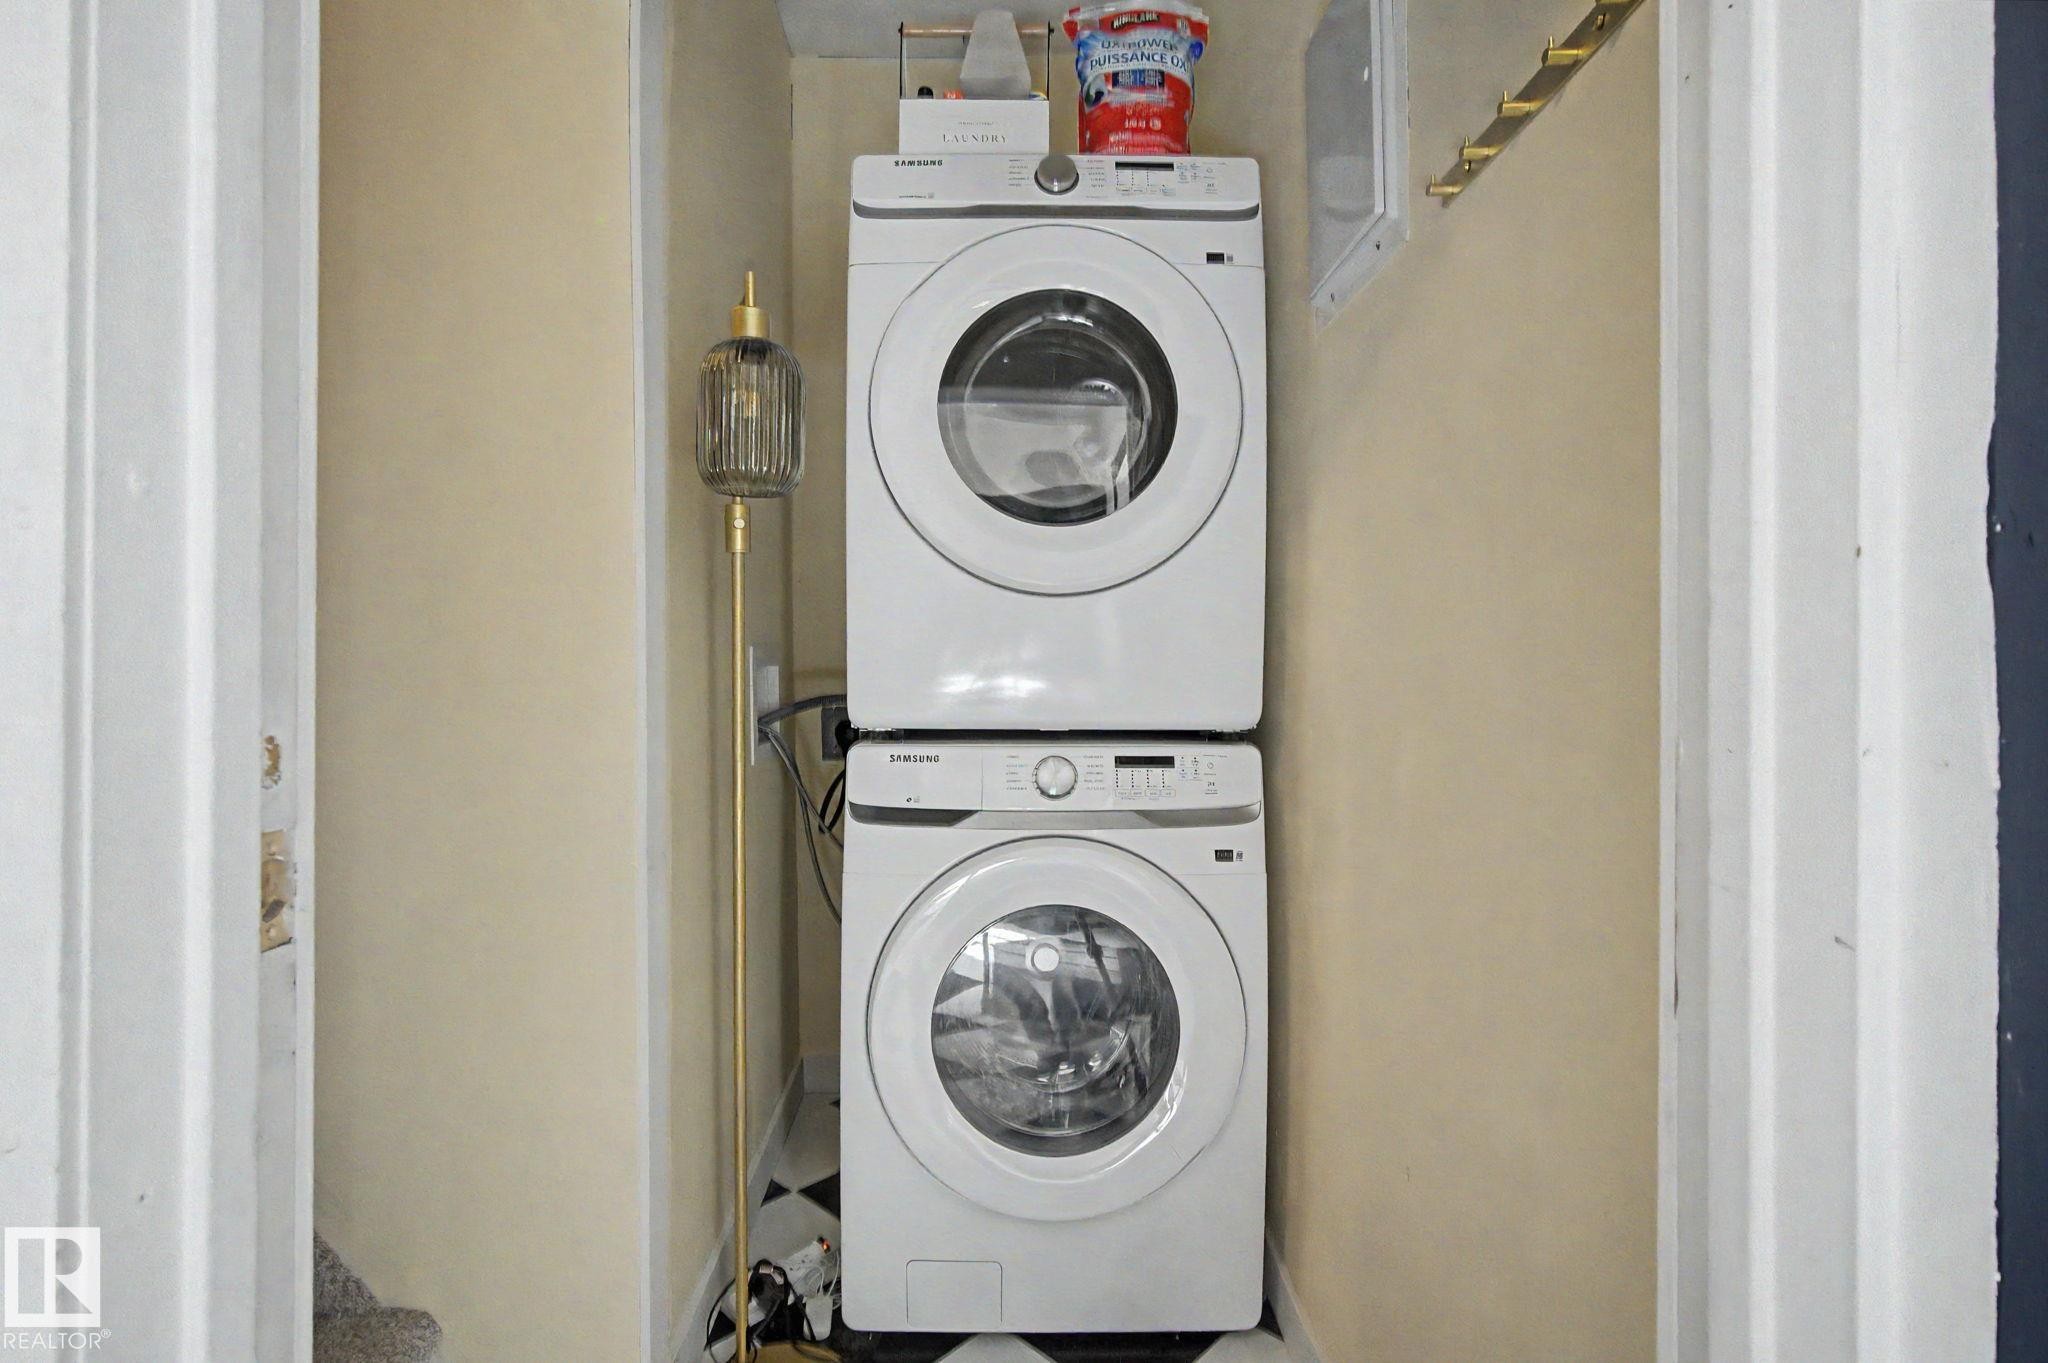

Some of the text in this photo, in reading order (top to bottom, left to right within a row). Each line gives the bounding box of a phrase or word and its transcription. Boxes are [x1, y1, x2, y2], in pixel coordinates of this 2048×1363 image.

[1090, 51, 1168, 71] PUISSANCE
[943, 133, 1007, 143] LAUNDRY
[894, 159, 943, 167] SAMSUNG
[889, 754, 940, 763] SAMSUNG
